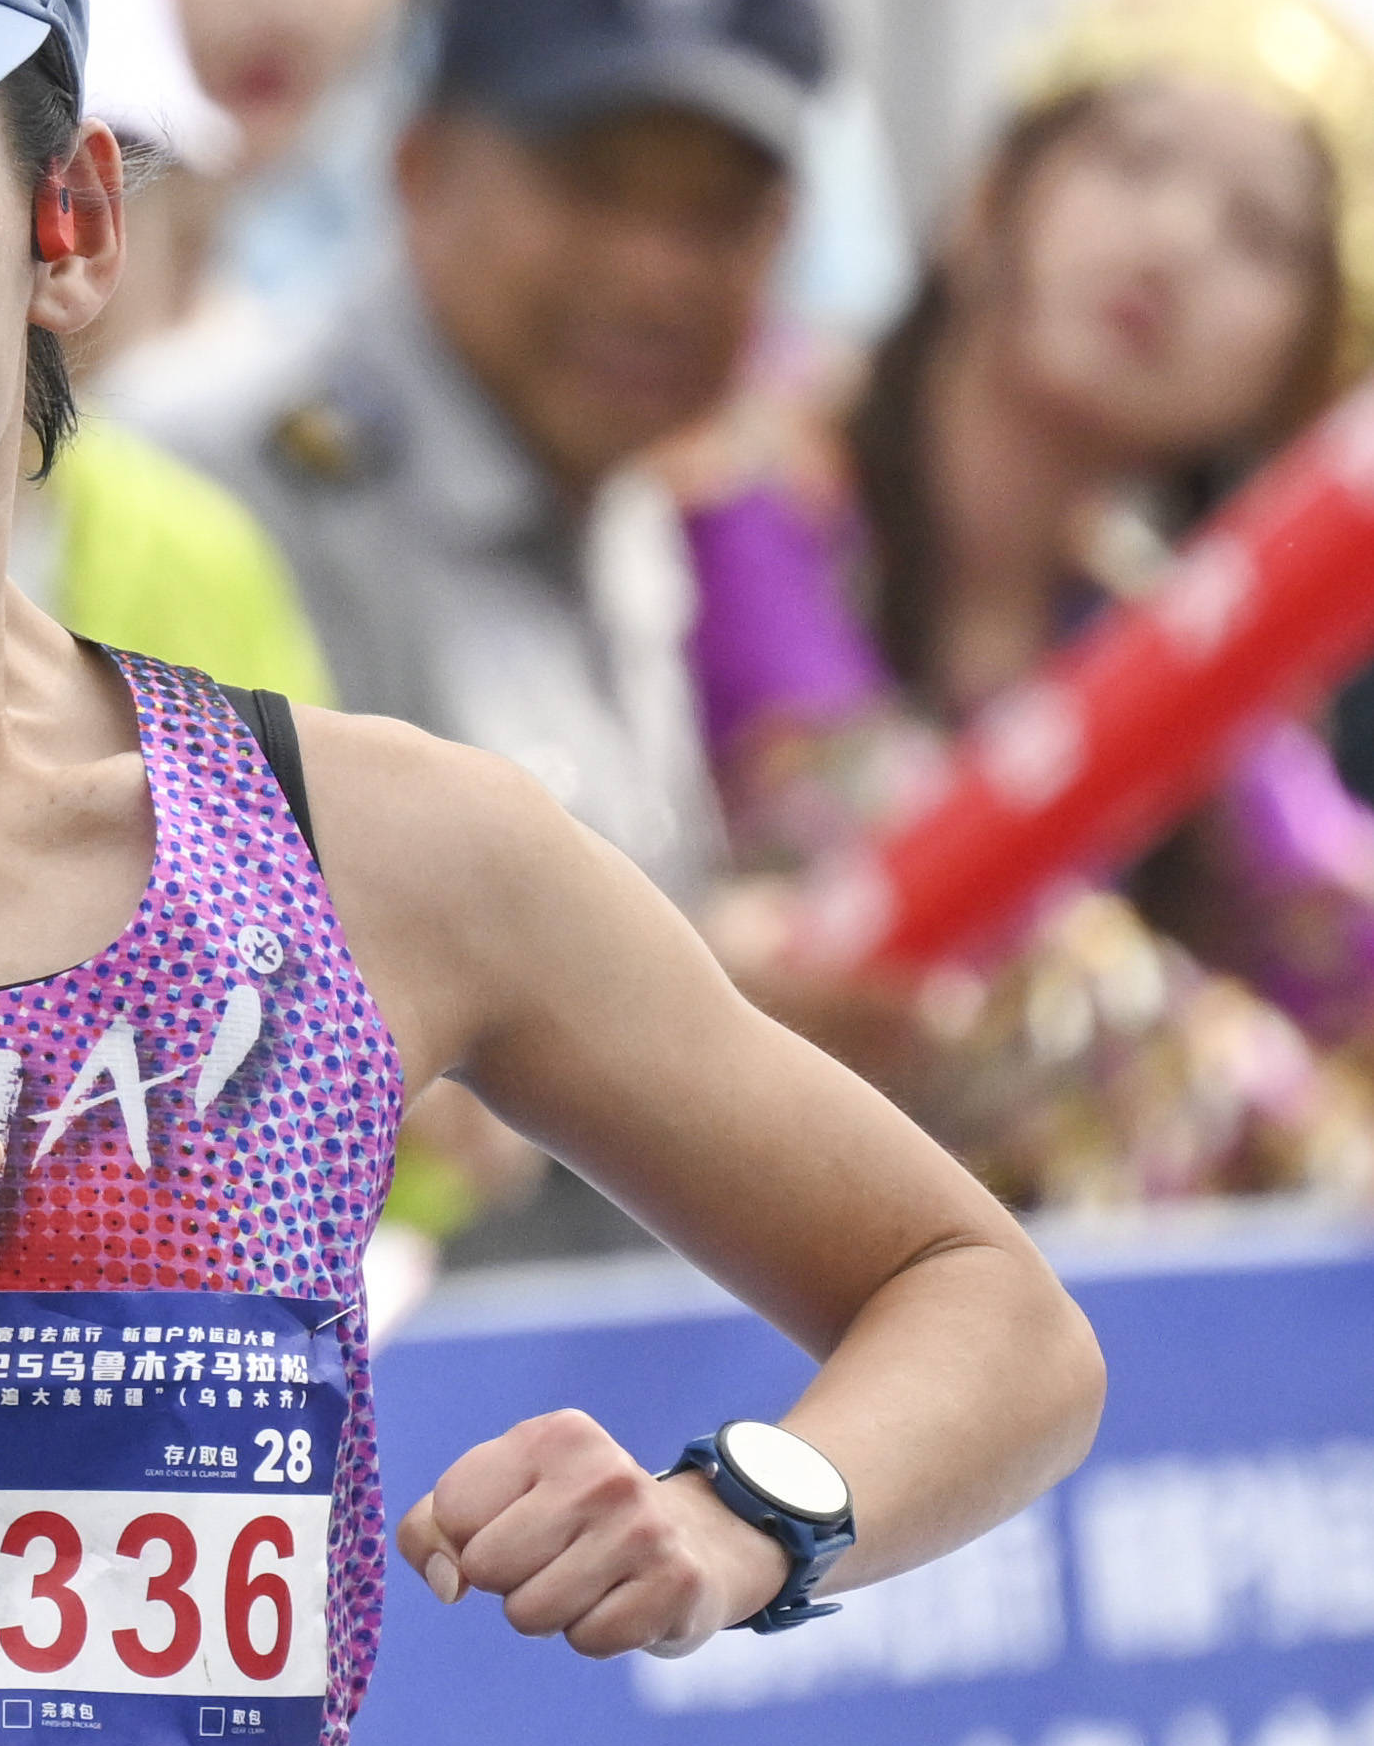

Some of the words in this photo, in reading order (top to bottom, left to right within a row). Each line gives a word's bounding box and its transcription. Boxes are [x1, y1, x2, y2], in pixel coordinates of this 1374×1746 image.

[122, 1326, 276, 1348] 新疆户外运动大赛
[164, 1444, 238, 1467] 存/取包
[253, 1428, 312, 1484] 28
[41, 1702, 94, 1720] 完赛包
